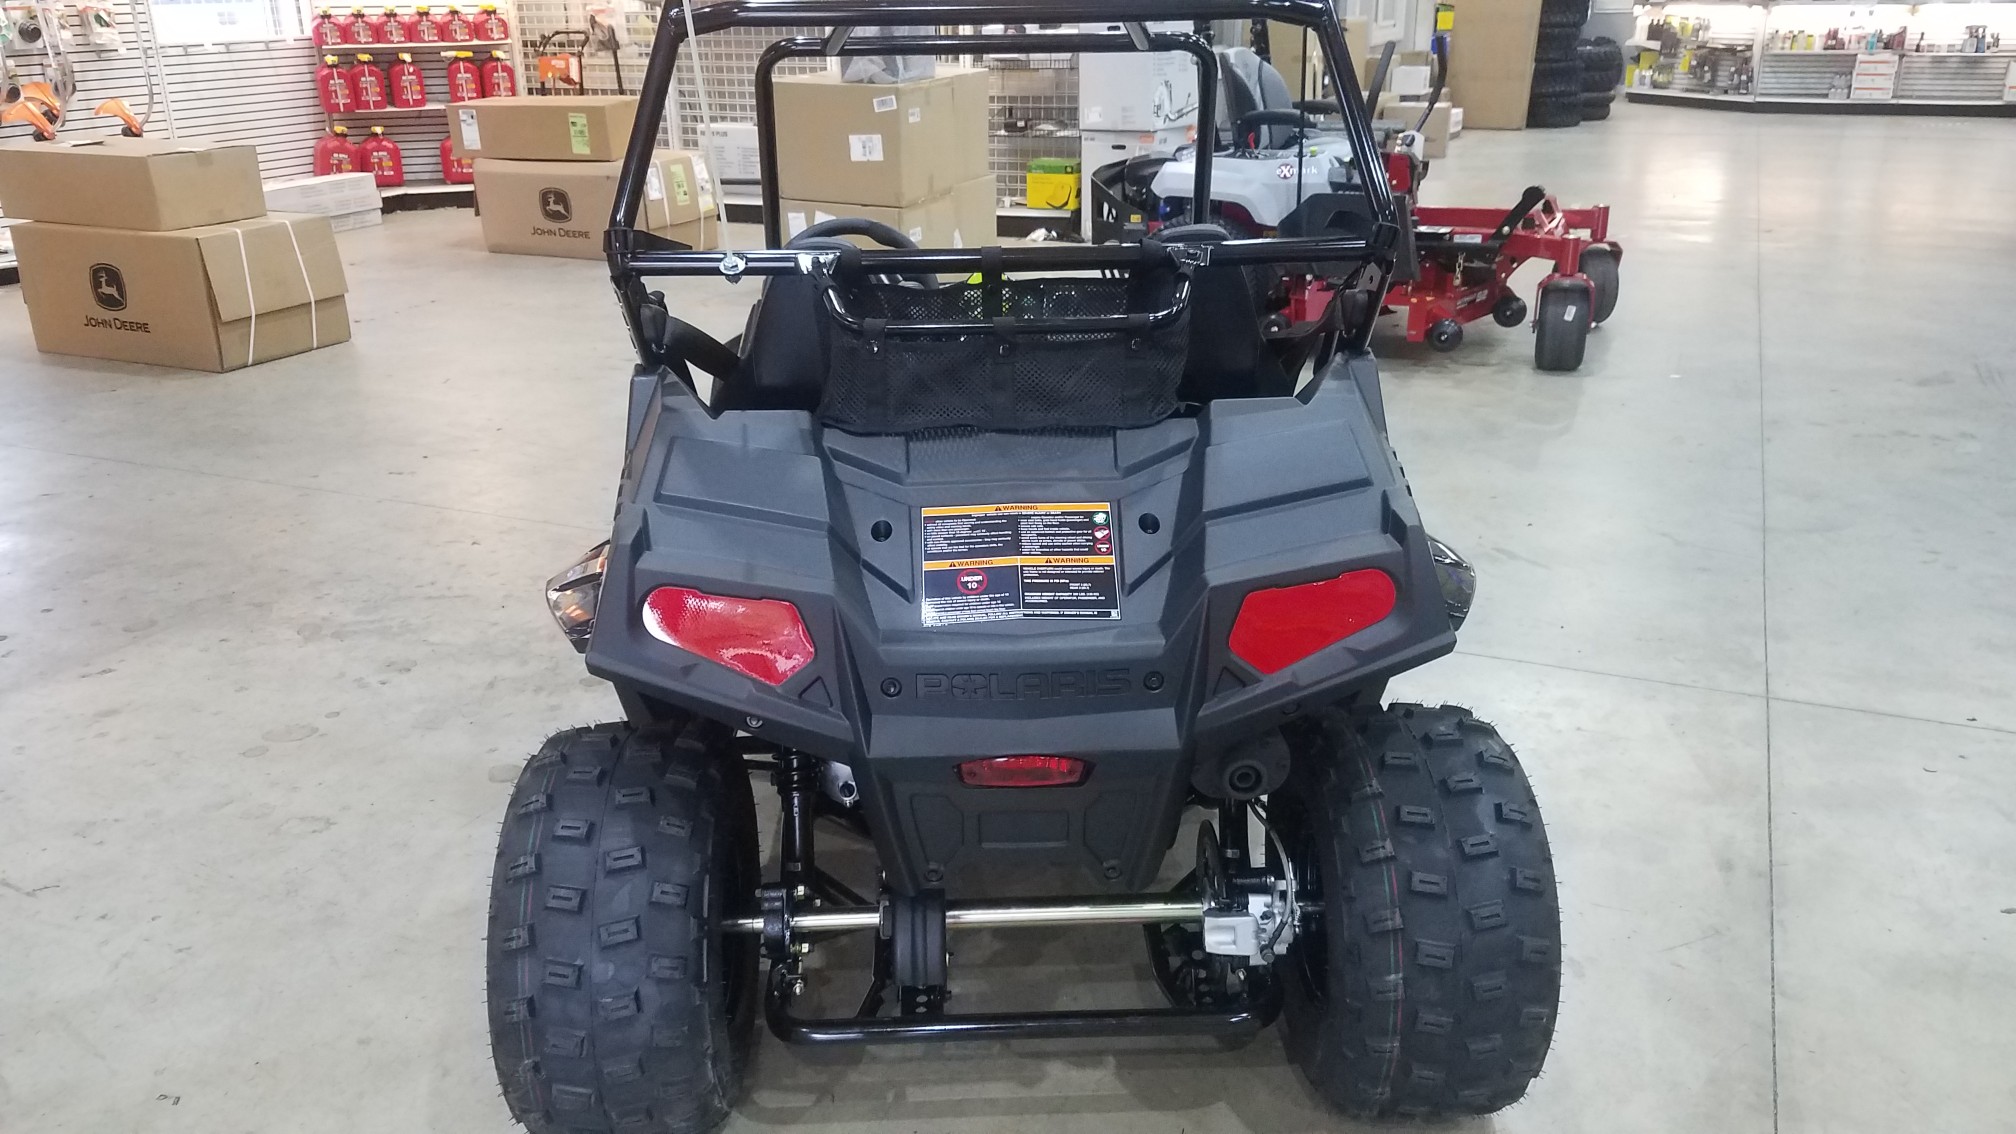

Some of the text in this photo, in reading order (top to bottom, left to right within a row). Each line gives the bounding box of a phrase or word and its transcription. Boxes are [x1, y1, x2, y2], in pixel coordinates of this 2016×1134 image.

[531, 226, 591, 239] JOHN DEERE
[84, 315, 151, 333] JOHN DEERE
[957, 559, 994, 567] WARNING
[915, 668, 1132, 699] POLARIS
